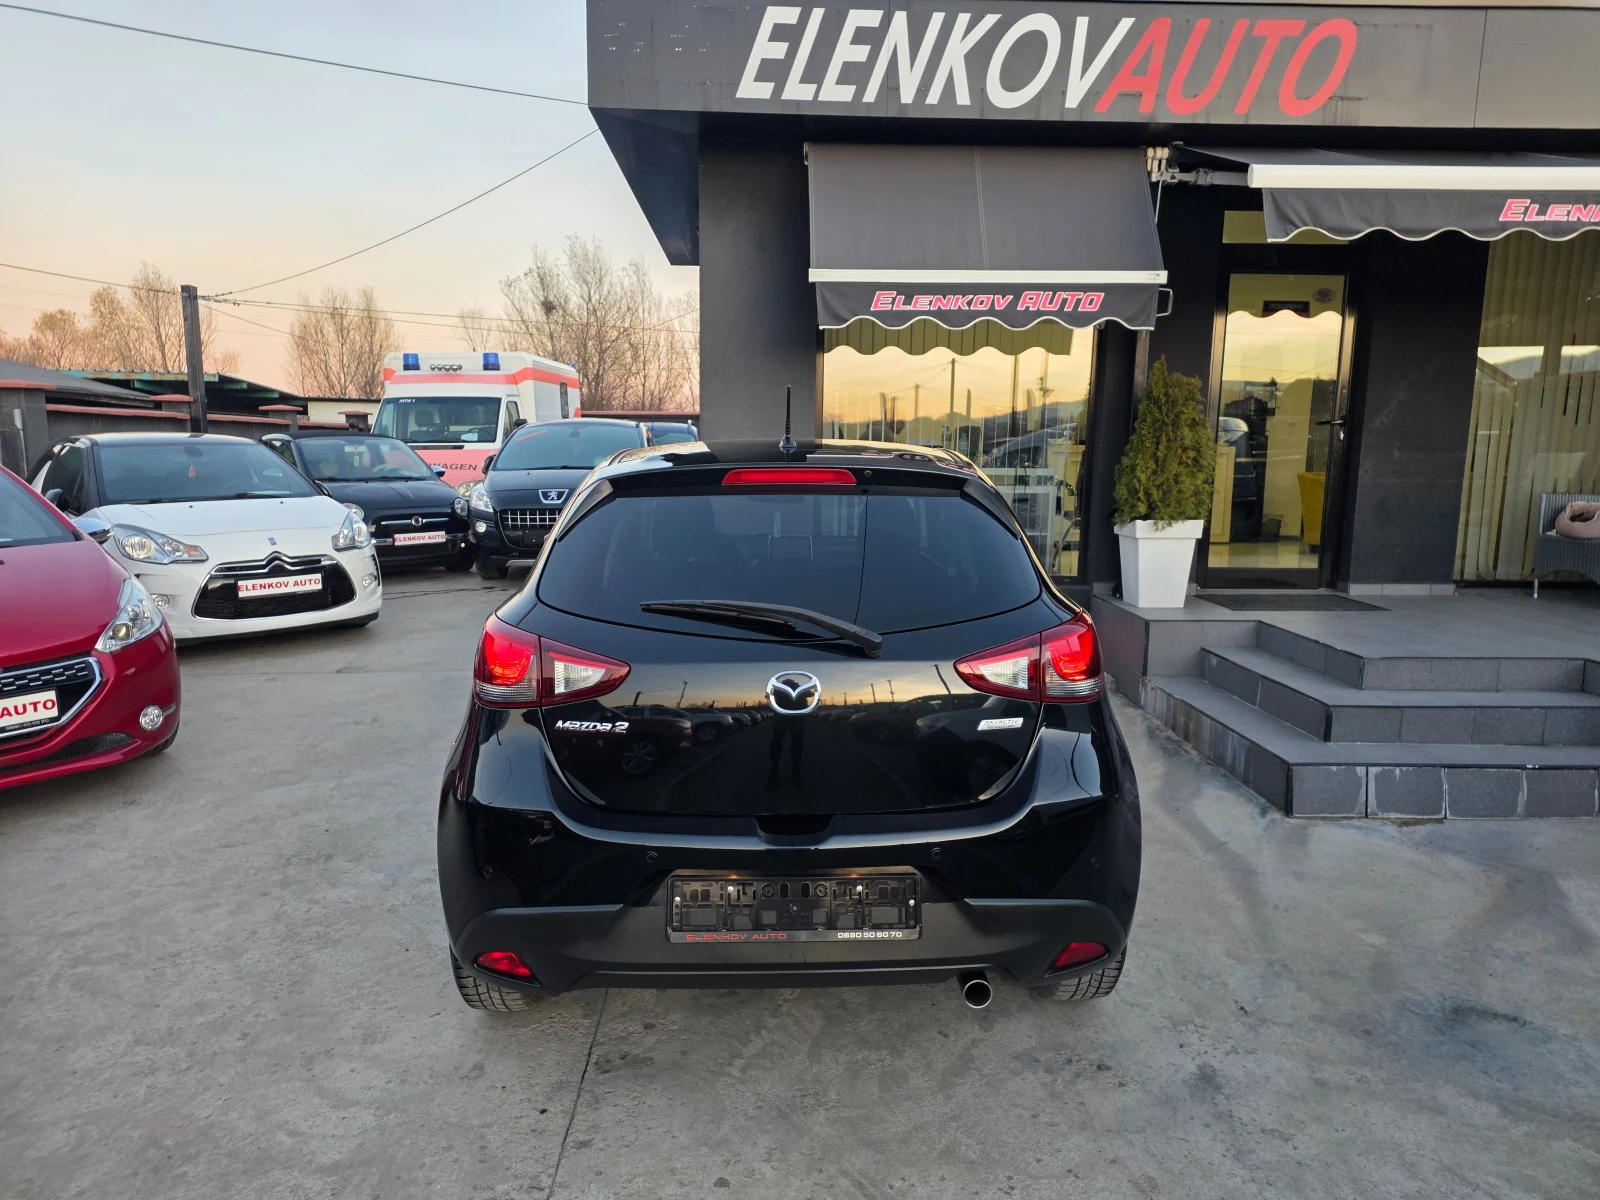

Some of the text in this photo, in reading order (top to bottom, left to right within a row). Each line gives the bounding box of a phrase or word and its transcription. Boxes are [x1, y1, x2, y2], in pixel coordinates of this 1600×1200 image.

[870, 291, 1105, 311] ELENKOV AUTO
[237, 581, 290, 593] ELENKOV
[293, 578, 321, 587] AUTO
[0, 699, 56, 719] AUTO
